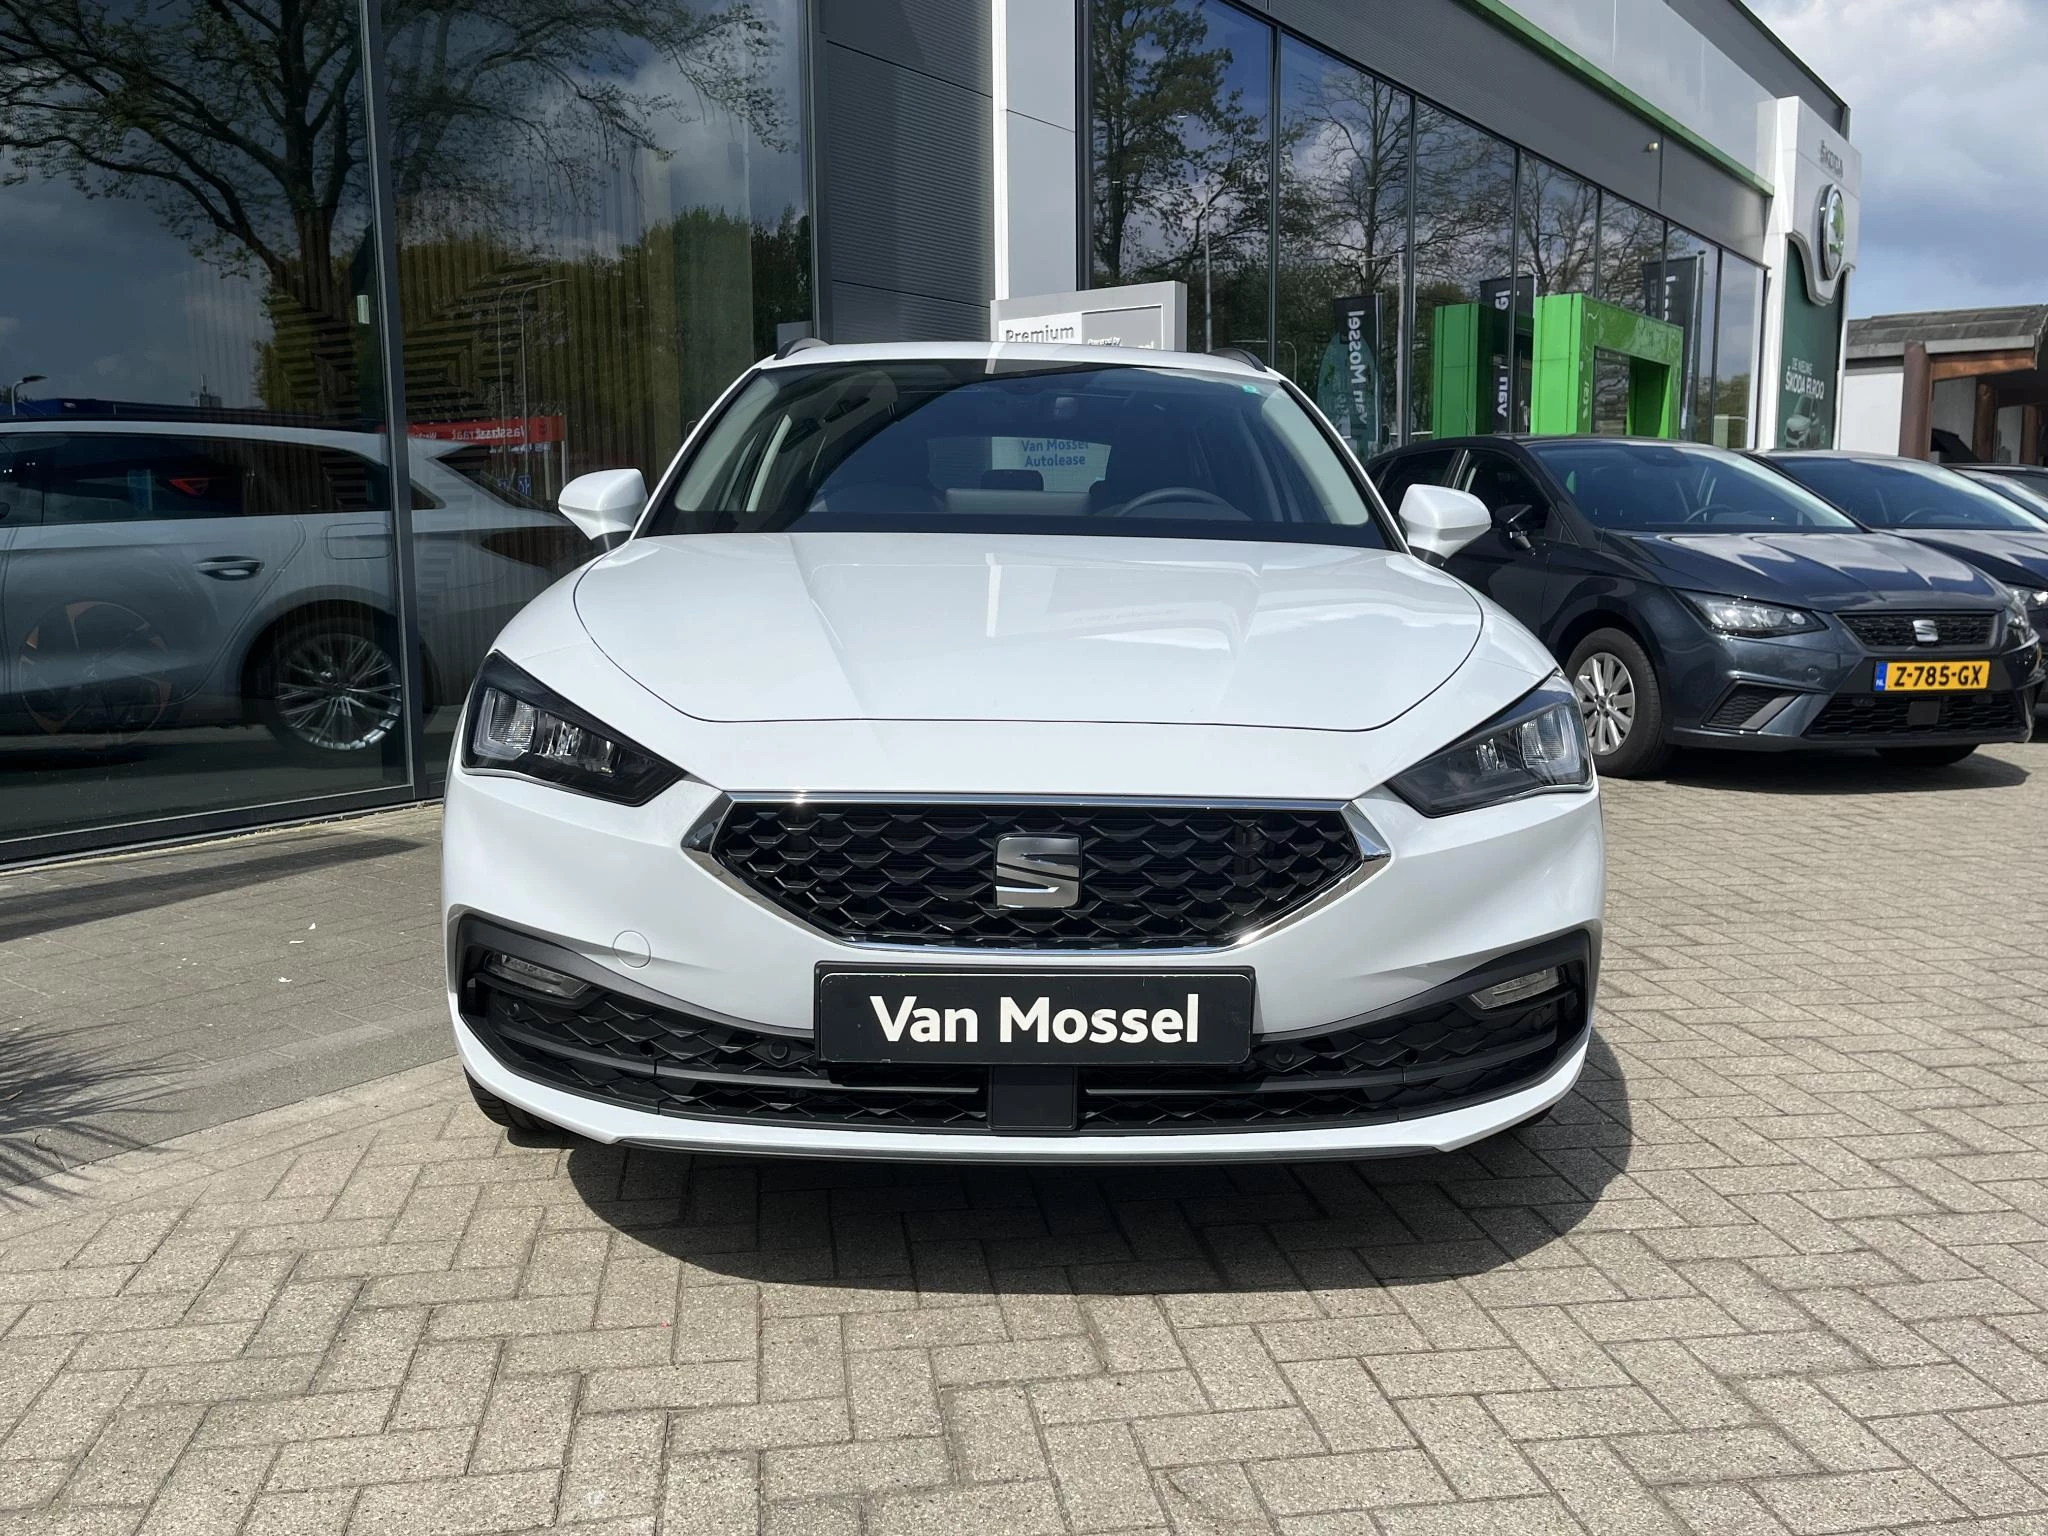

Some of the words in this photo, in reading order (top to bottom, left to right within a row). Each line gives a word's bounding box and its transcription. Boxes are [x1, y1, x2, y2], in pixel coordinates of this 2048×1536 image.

[1005, 324, 1075, 342] Premium
[1785, 366, 1806, 394] ŠKODA
[1021, 439, 1043, 452] Van
[1024, 454, 1086, 467] Autolease
[1893, 664, 1983, 687] Z-785-GX
[869, 995, 978, 1043] Van
[1000, 993, 1199, 1044] Mossel
